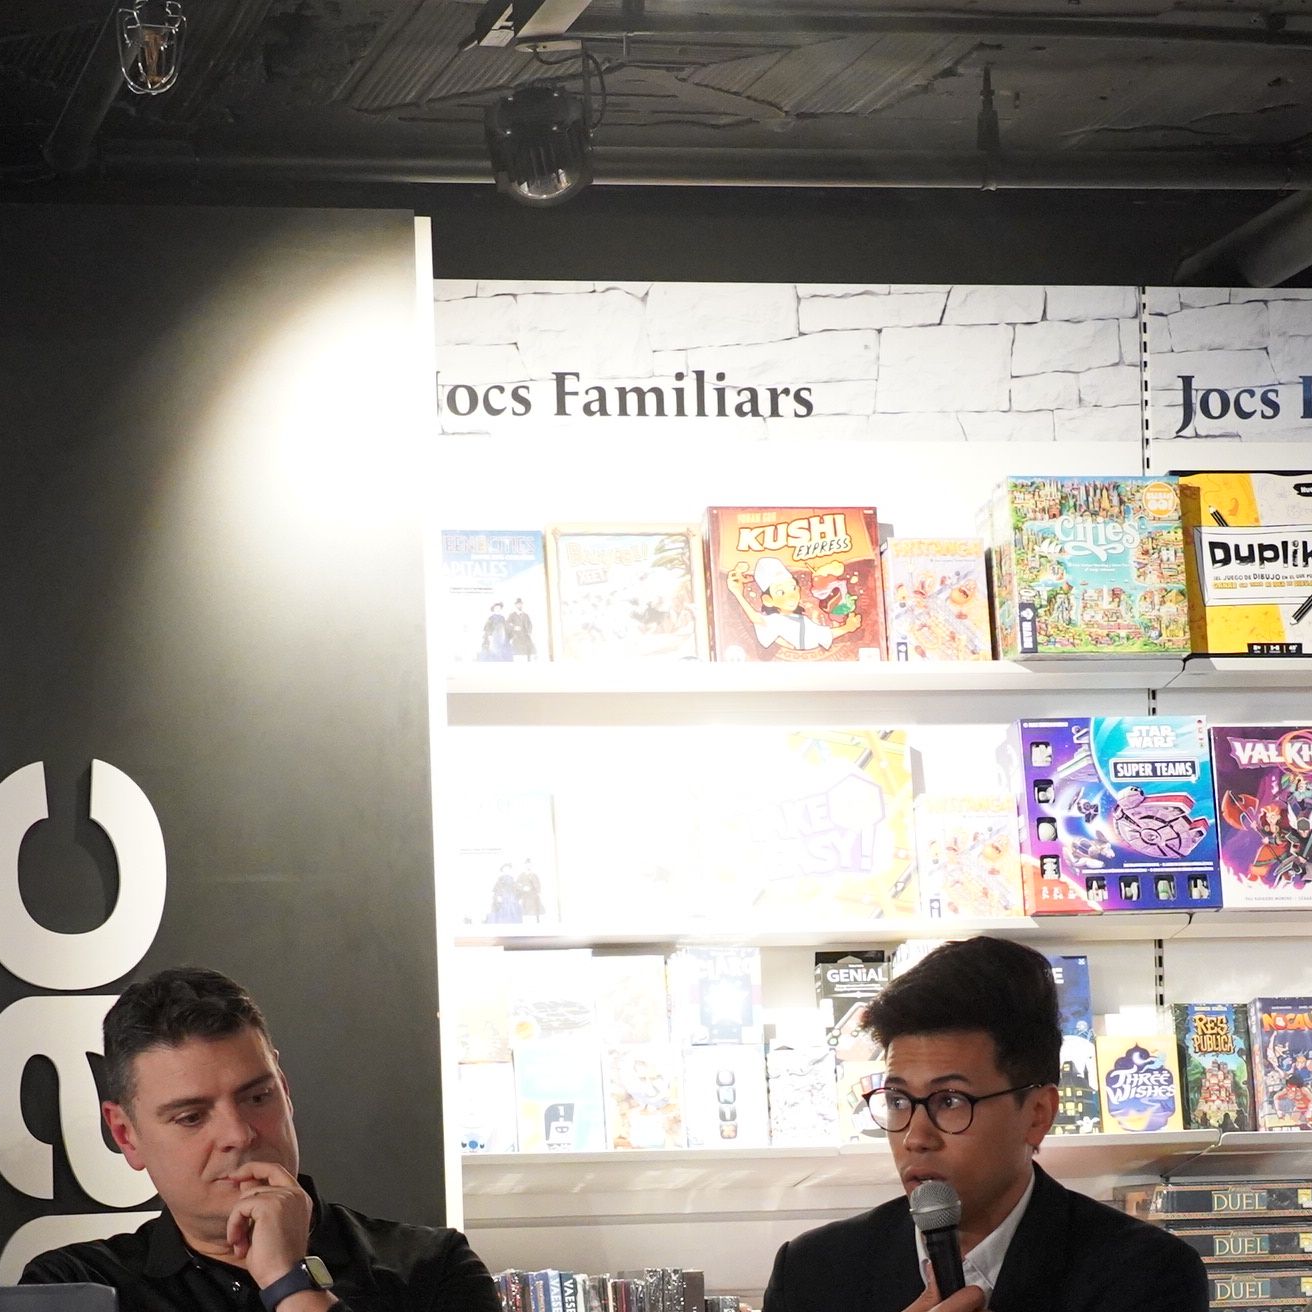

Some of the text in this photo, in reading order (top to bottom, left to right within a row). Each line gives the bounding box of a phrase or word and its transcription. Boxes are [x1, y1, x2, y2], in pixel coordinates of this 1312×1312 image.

[436, 371, 815, 419] ocs Familiars
[1175, 374, 1281, 437] Jocs
[737, 513, 848, 551] KUSHI
[796, 538, 849, 557] EXPRESS
[1127, 725, 1175, 737] STAR
[1126, 736, 1177, 748] WARS
[1117, 762, 1193, 777] SUPER TEAMS
[1194, 1015, 1229, 1034] RES
[1193, 1035, 1235, 1053] PUBLICA
[1213, 1193, 1266, 1211] DUEL
[1215, 1237, 1268, 1255] DUEL
[1216, 1281, 1269, 1299] DUEL
